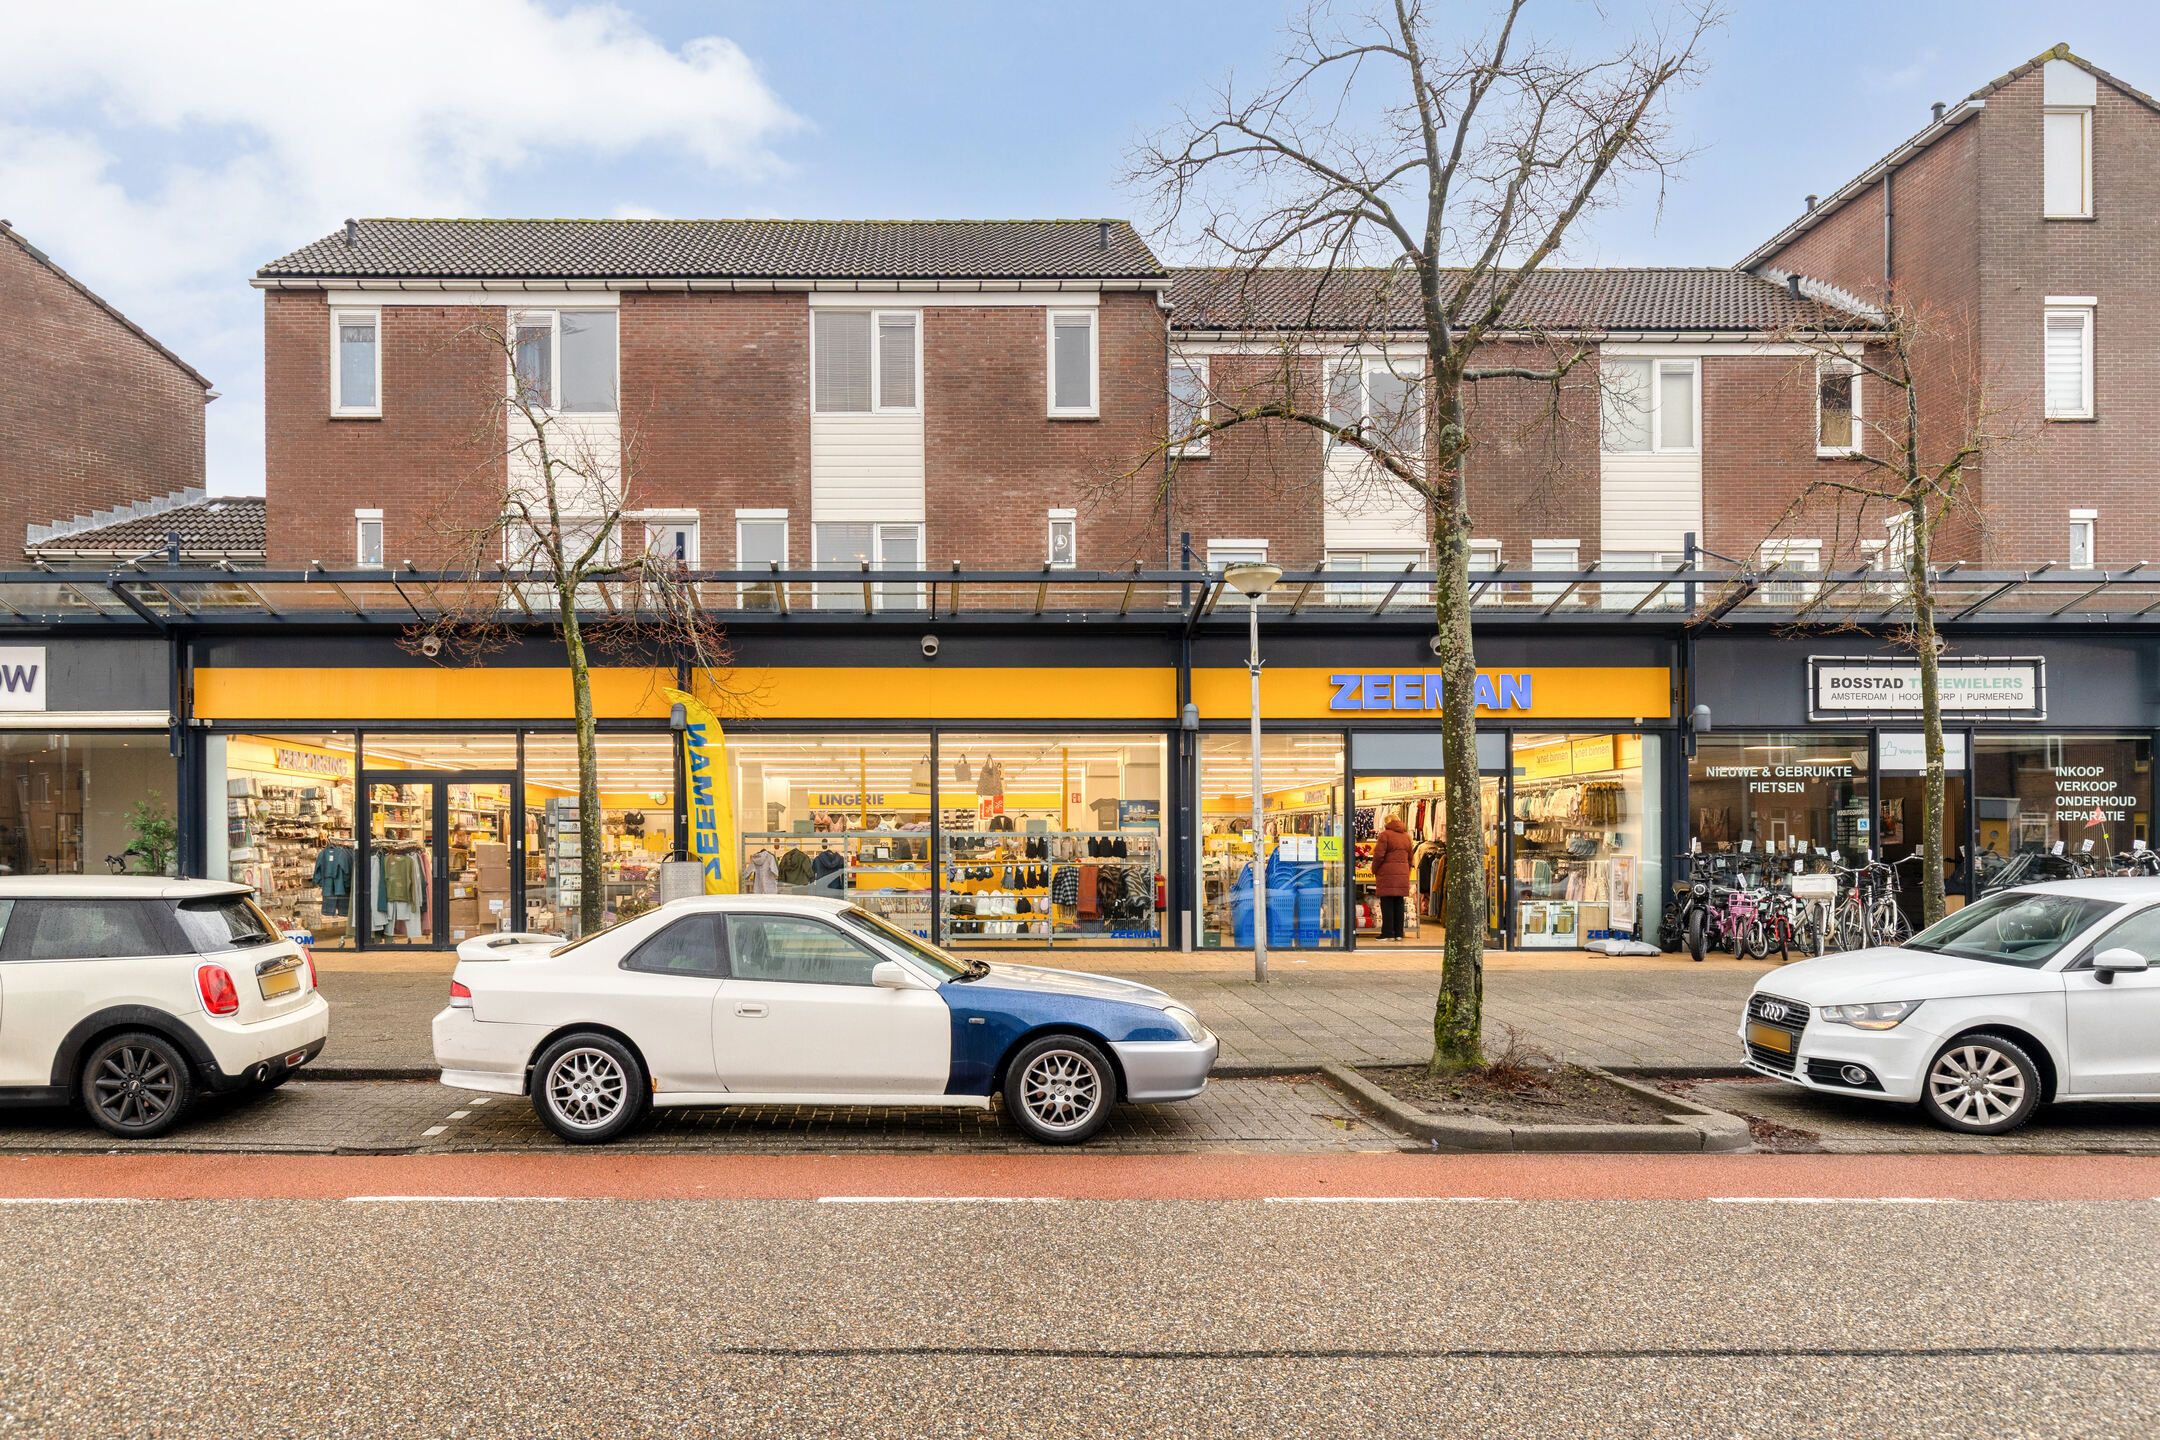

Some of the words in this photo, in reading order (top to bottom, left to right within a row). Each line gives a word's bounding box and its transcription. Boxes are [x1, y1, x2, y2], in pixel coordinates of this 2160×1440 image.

[0, 665, 38, 692] W
[1830, 677, 1904, 689] BOSSTAD
[1909, 677, 2023, 689] TEEWIELERS
[1831, 692, 1887, 700] AMSTERDAM
[1898, 692, 1956, 700] HOOFORP
[1967, 692, 2024, 700] PURMEREND
[1706, 766, 1758, 777] NIEUWE
[1761, 766, 1772, 777] &
[1775, 766, 1853, 777] GEBRUIKTE
[2055, 766, 2104, 777] INKOOP
[1750, 782, 1805, 793] FIETSEN
[2055, 781, 2118, 792] VERKOOP
[2055, 796, 2137, 807] ONDERHOUD
[2055, 810, 2126, 821] REPARATIE
[1323, 840, 1338, 851] XL
[1110, 929, 1161, 938] ZEEMAN
